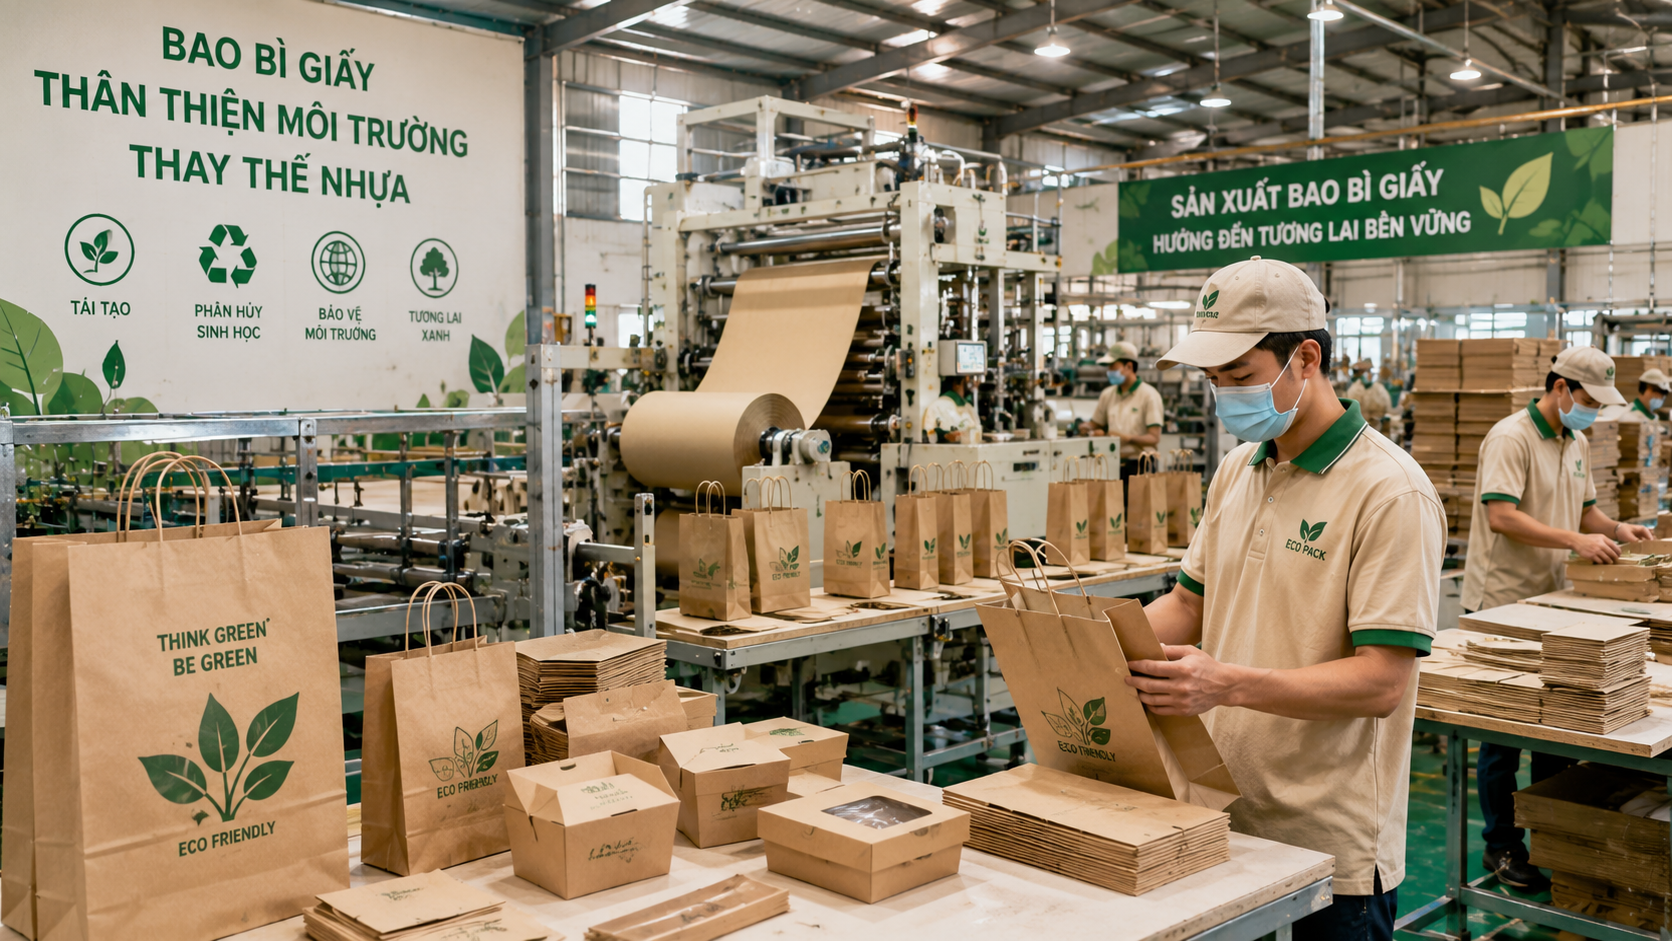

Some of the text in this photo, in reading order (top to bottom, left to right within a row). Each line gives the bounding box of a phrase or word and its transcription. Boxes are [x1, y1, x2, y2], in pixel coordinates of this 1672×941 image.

[163, 26, 374, 91] BAO BÌ GIẤY
[34, 70, 467, 157] THÂN THIỆN MÔI TRƯỜNG
[129, 144, 410, 208] THAY THẾ NHỰA
[1171, 161, 1444, 218] SẢN XUẤT BAO BÌ GIẤY
[1218, 221, 1253, 249] ĐẾN
[1258, 221, 1322, 246] TƯƠNG
[1329, 220, 1358, 241] LAI
[1410, 208, 1471, 236] VỮNG
[101, 301, 131, 319] TẠO
[195, 302, 231, 317] PHÂN
[447, 312, 461, 323] LAI
[198, 325, 260, 342] SINH HỌC
[422, 330, 450, 341] XANH
[1286, 539, 1326, 561] ECO PACK
[157, 629, 210, 651] THINK
[173, 646, 257, 676] BE GREEN
[437, 784, 456, 799] ECO
[179, 821, 276, 857] ECO FRIENDLY
